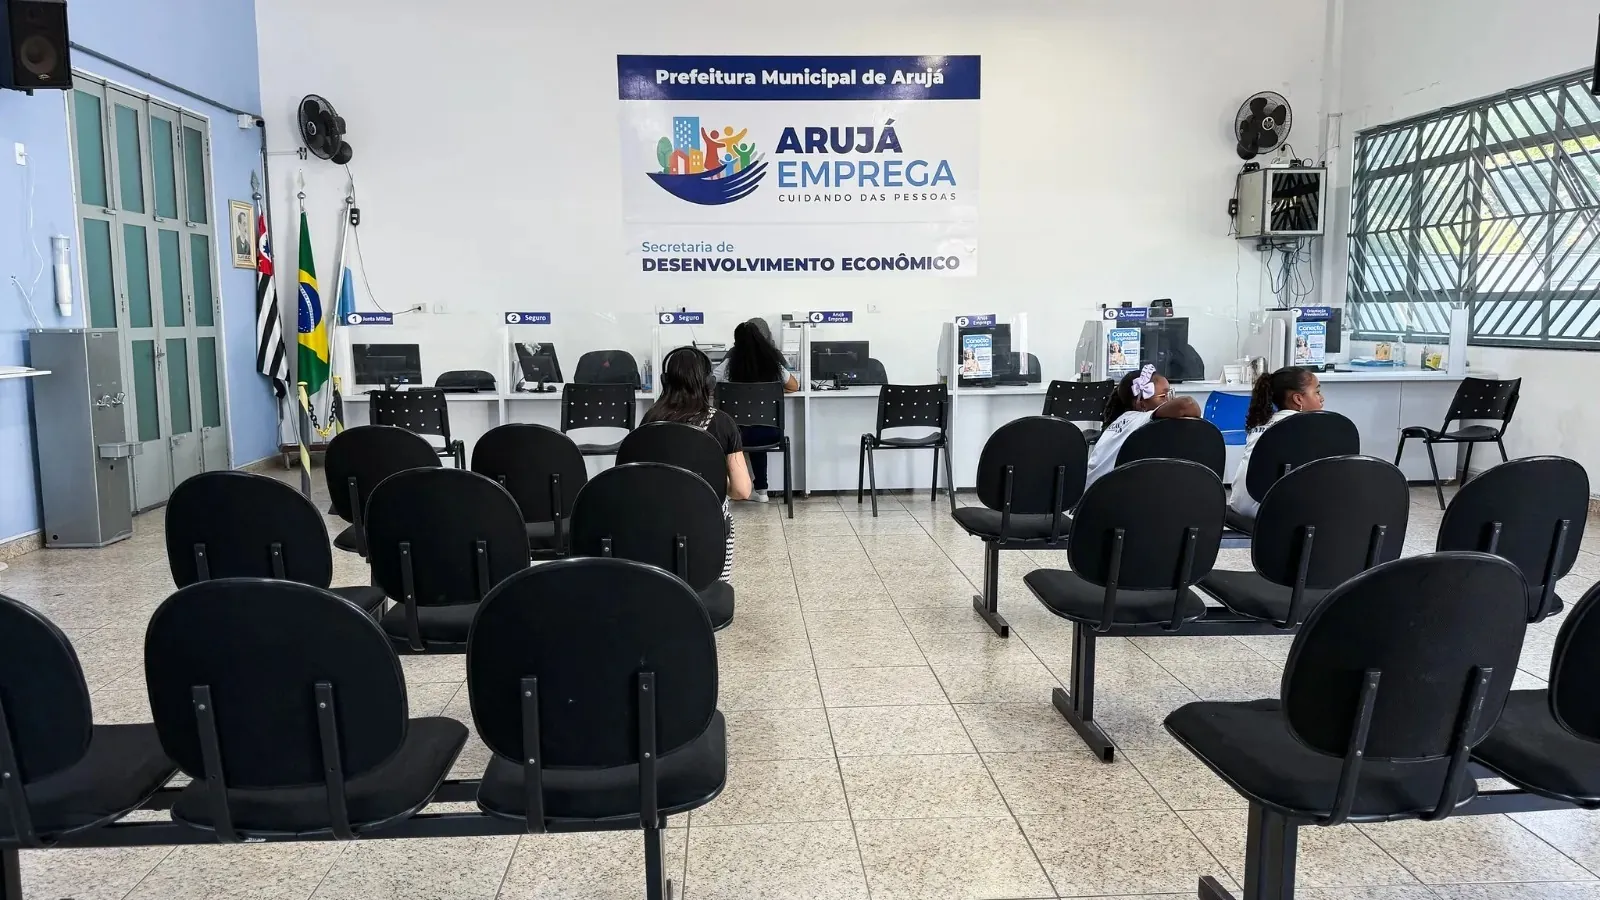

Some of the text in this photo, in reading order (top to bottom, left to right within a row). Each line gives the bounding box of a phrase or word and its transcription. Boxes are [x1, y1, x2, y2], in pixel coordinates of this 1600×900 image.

[656, 68, 944, 88] Prefeitura Municipal de Arujá
[775, 118, 903, 154] ARUJÁ
[778, 160, 957, 188] EMPREGA
[778, 192, 957, 203] CUIDANDO DAS PESSOAS
[641, 241, 735, 253] Secretaria de
[642, 253, 960, 272] DESENVOLVIMENTO ECONÔMICO
[352, 315, 357, 323] 1
